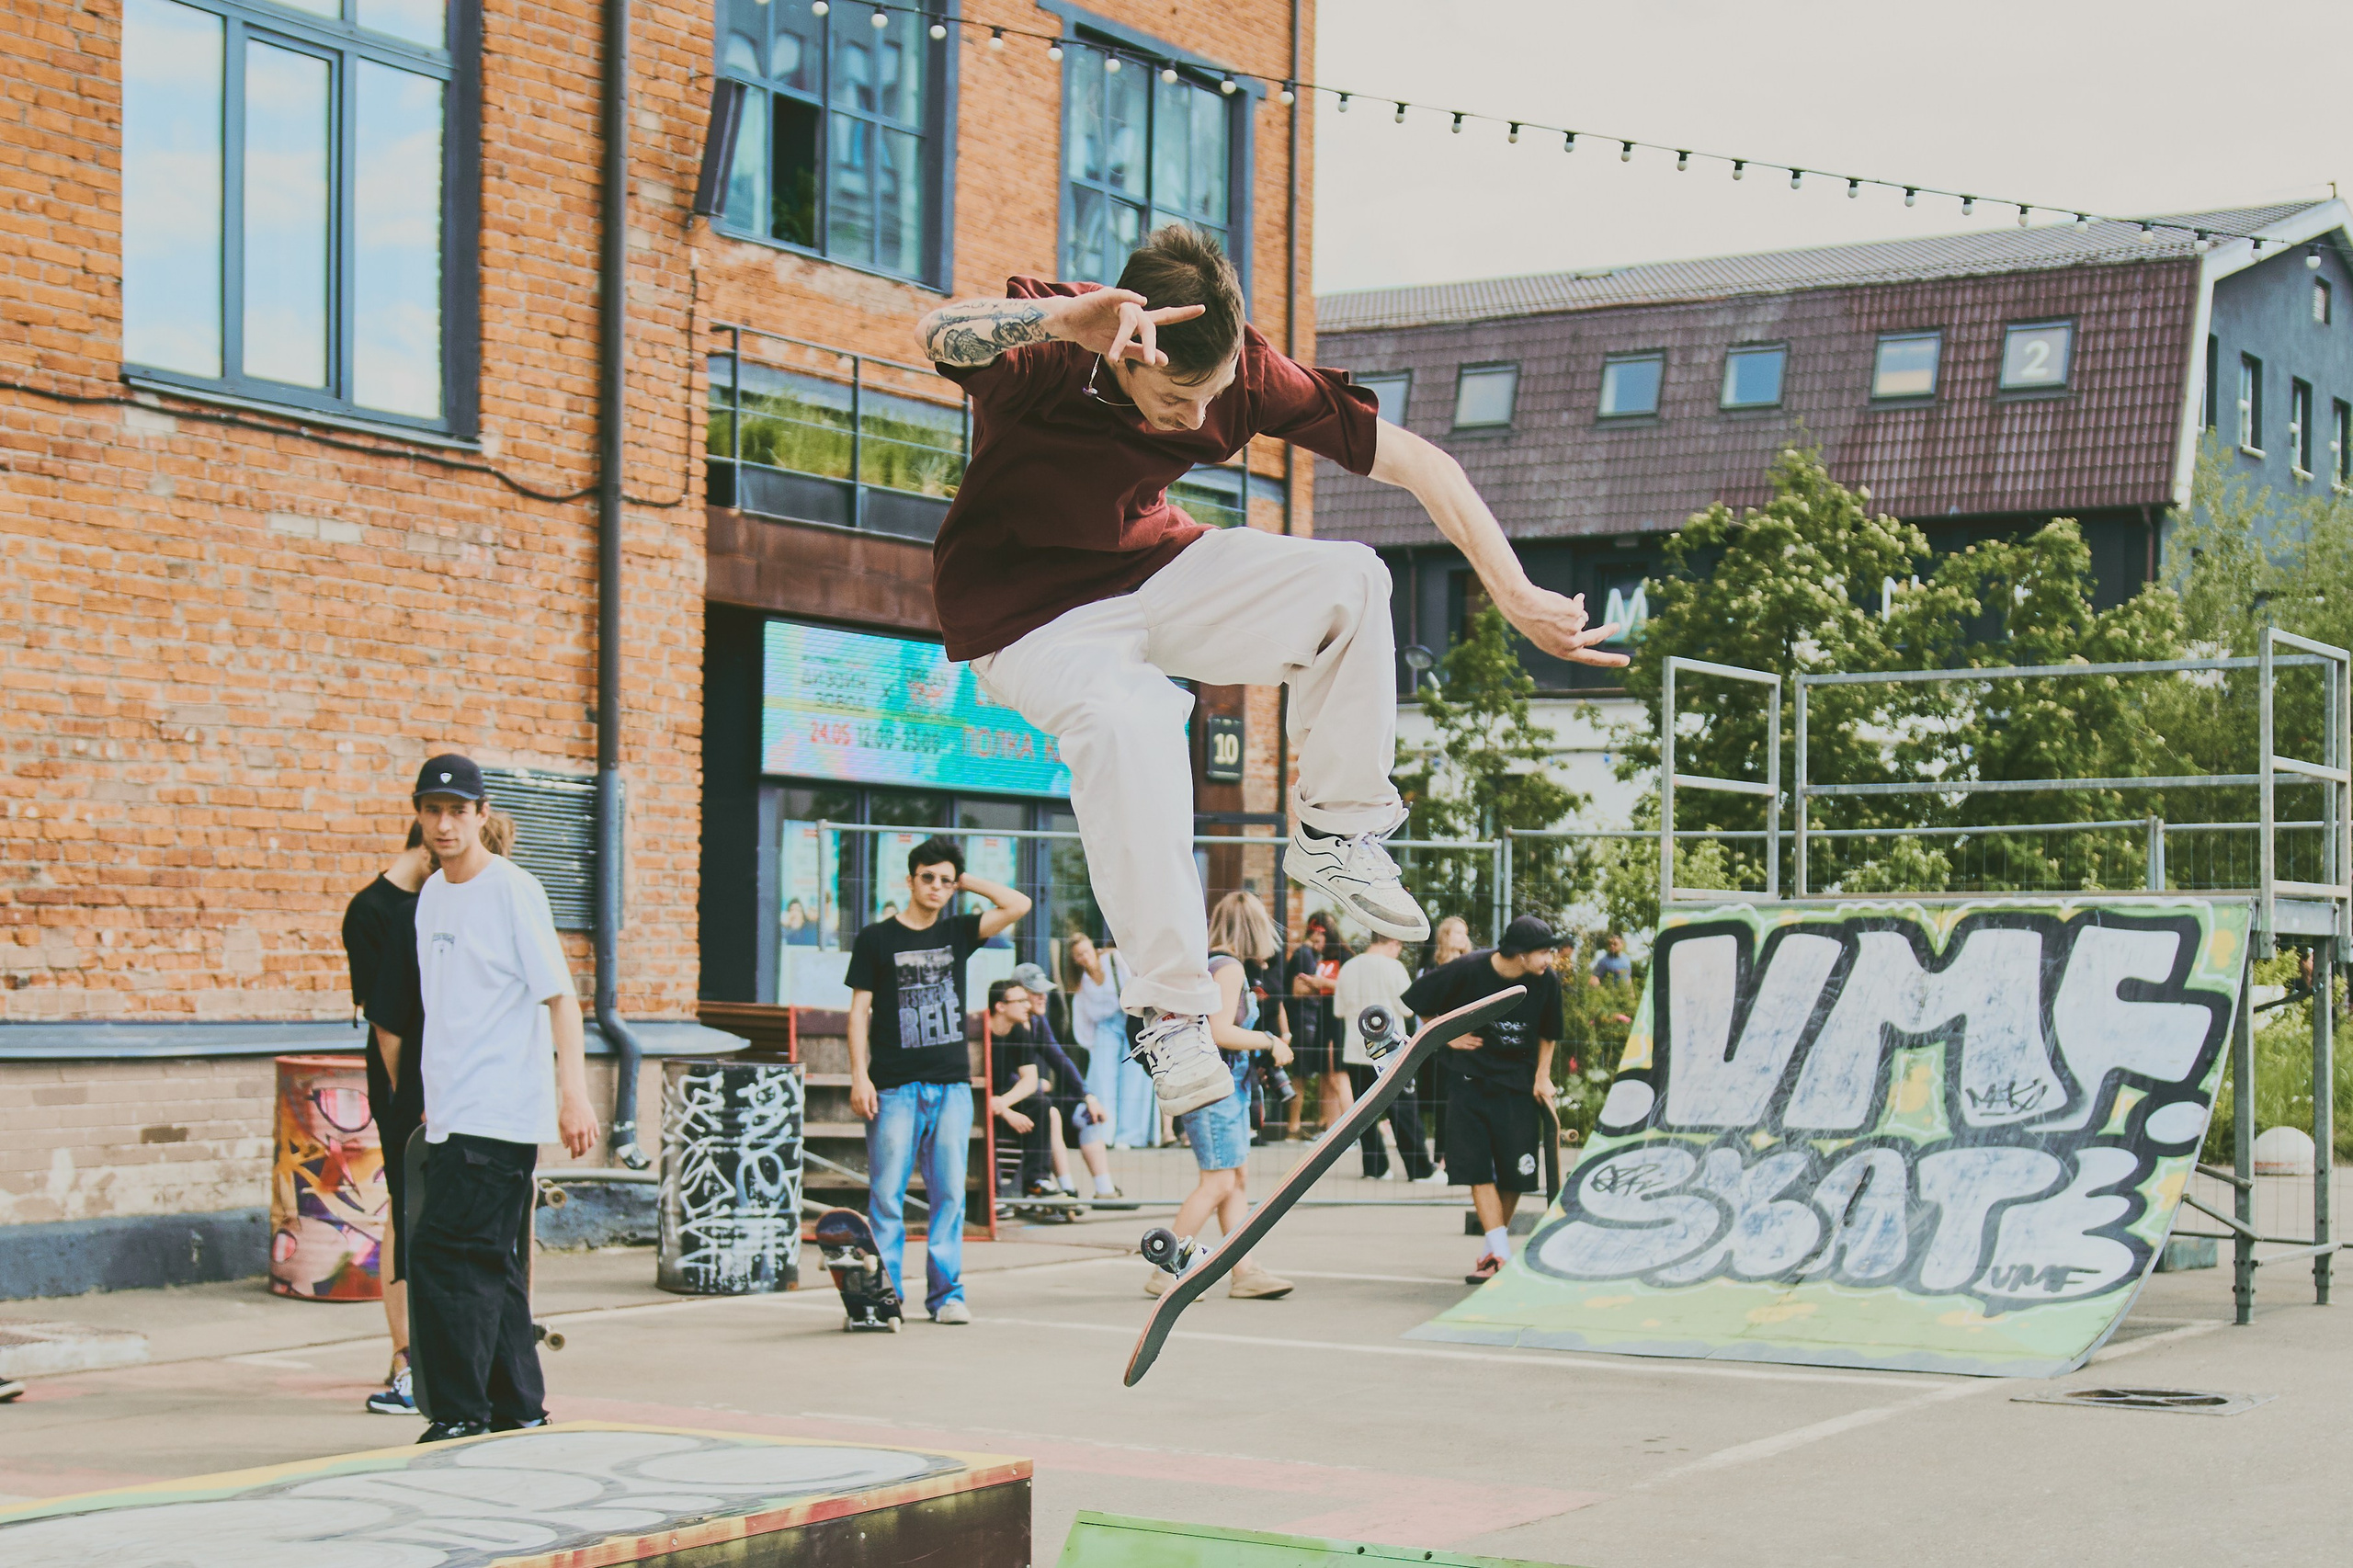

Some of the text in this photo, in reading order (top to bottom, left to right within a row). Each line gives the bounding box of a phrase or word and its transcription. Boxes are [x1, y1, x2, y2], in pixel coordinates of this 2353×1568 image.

[2021, 339, 2050, 379] 2
[962, 726, 1035, 762] ПОЛКА
[1214, 733, 1239, 765] 10
[1656, 915, 2229, 1136] VMF
[1528, 1140, 2149, 1301] SKATE
